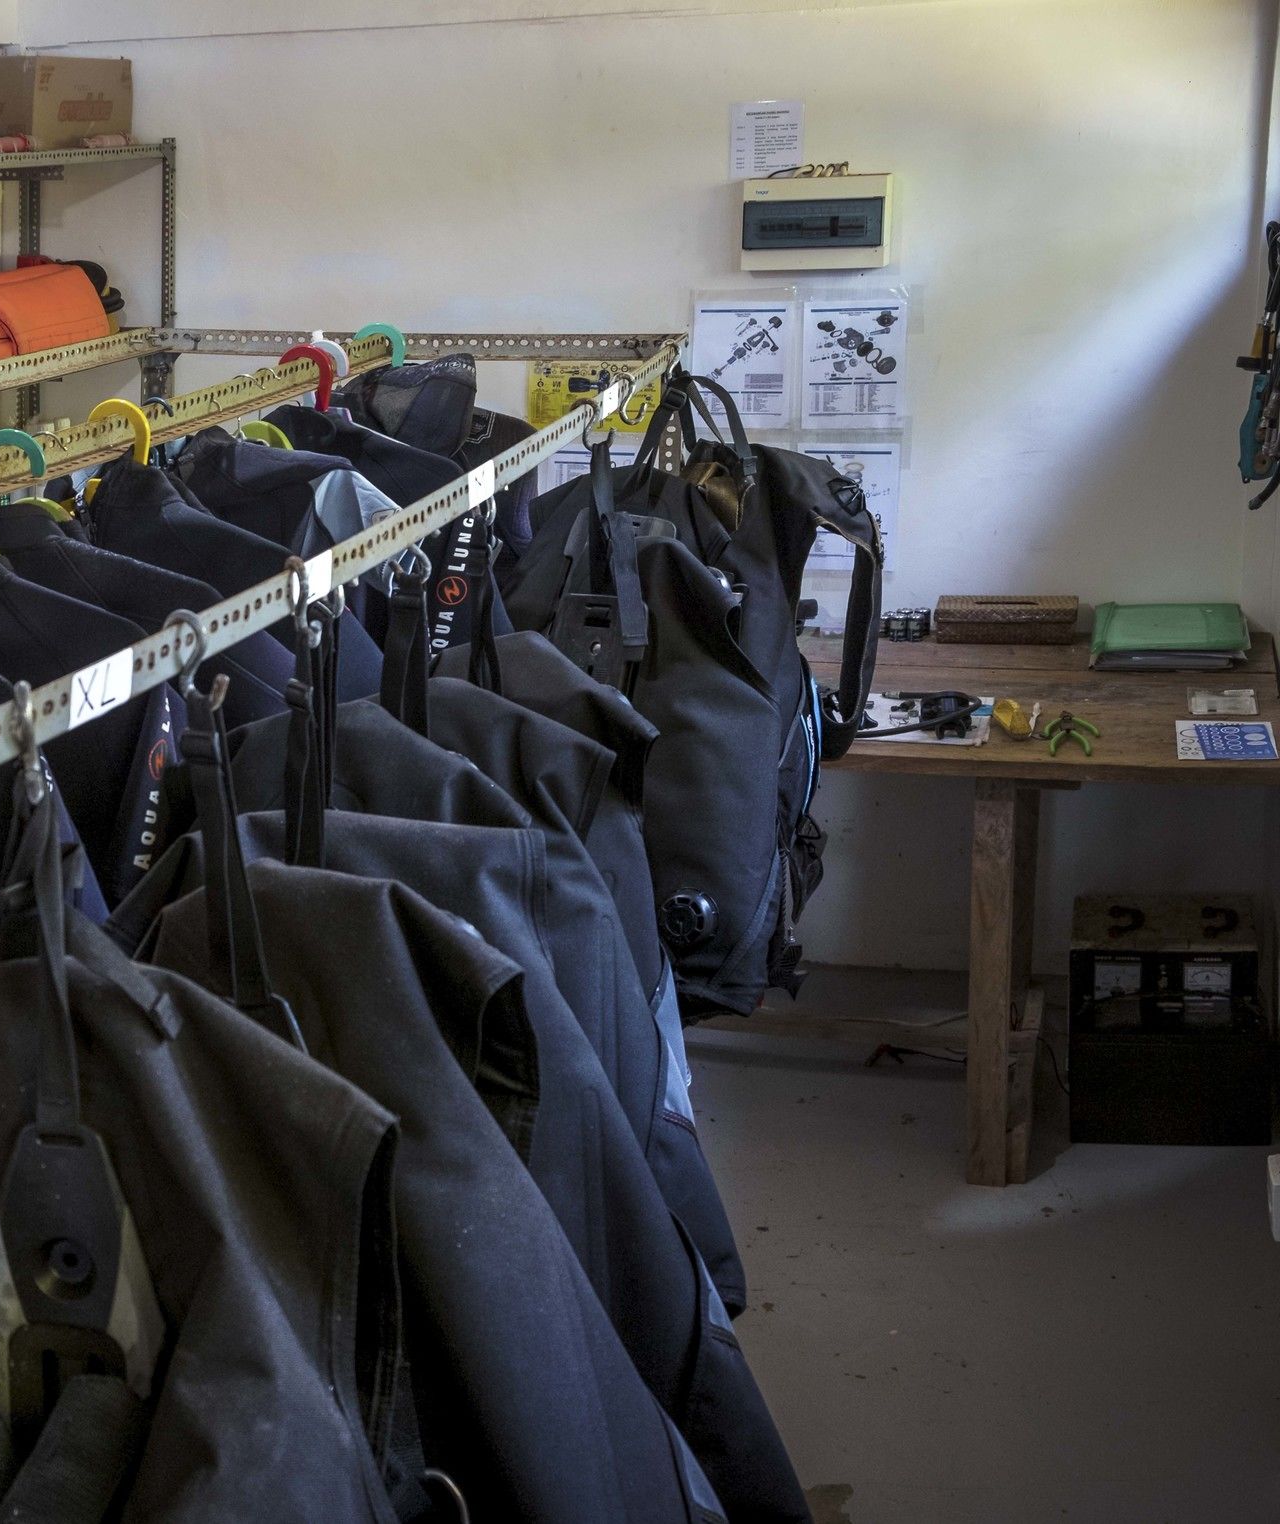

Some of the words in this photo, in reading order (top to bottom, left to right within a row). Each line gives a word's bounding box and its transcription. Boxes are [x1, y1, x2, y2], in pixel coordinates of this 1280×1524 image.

[430, 611, 454, 658] QUA
[448, 517, 474, 572] LUNG
[77, 663, 116, 718] XL
[133, 790, 160, 871] AQUA
